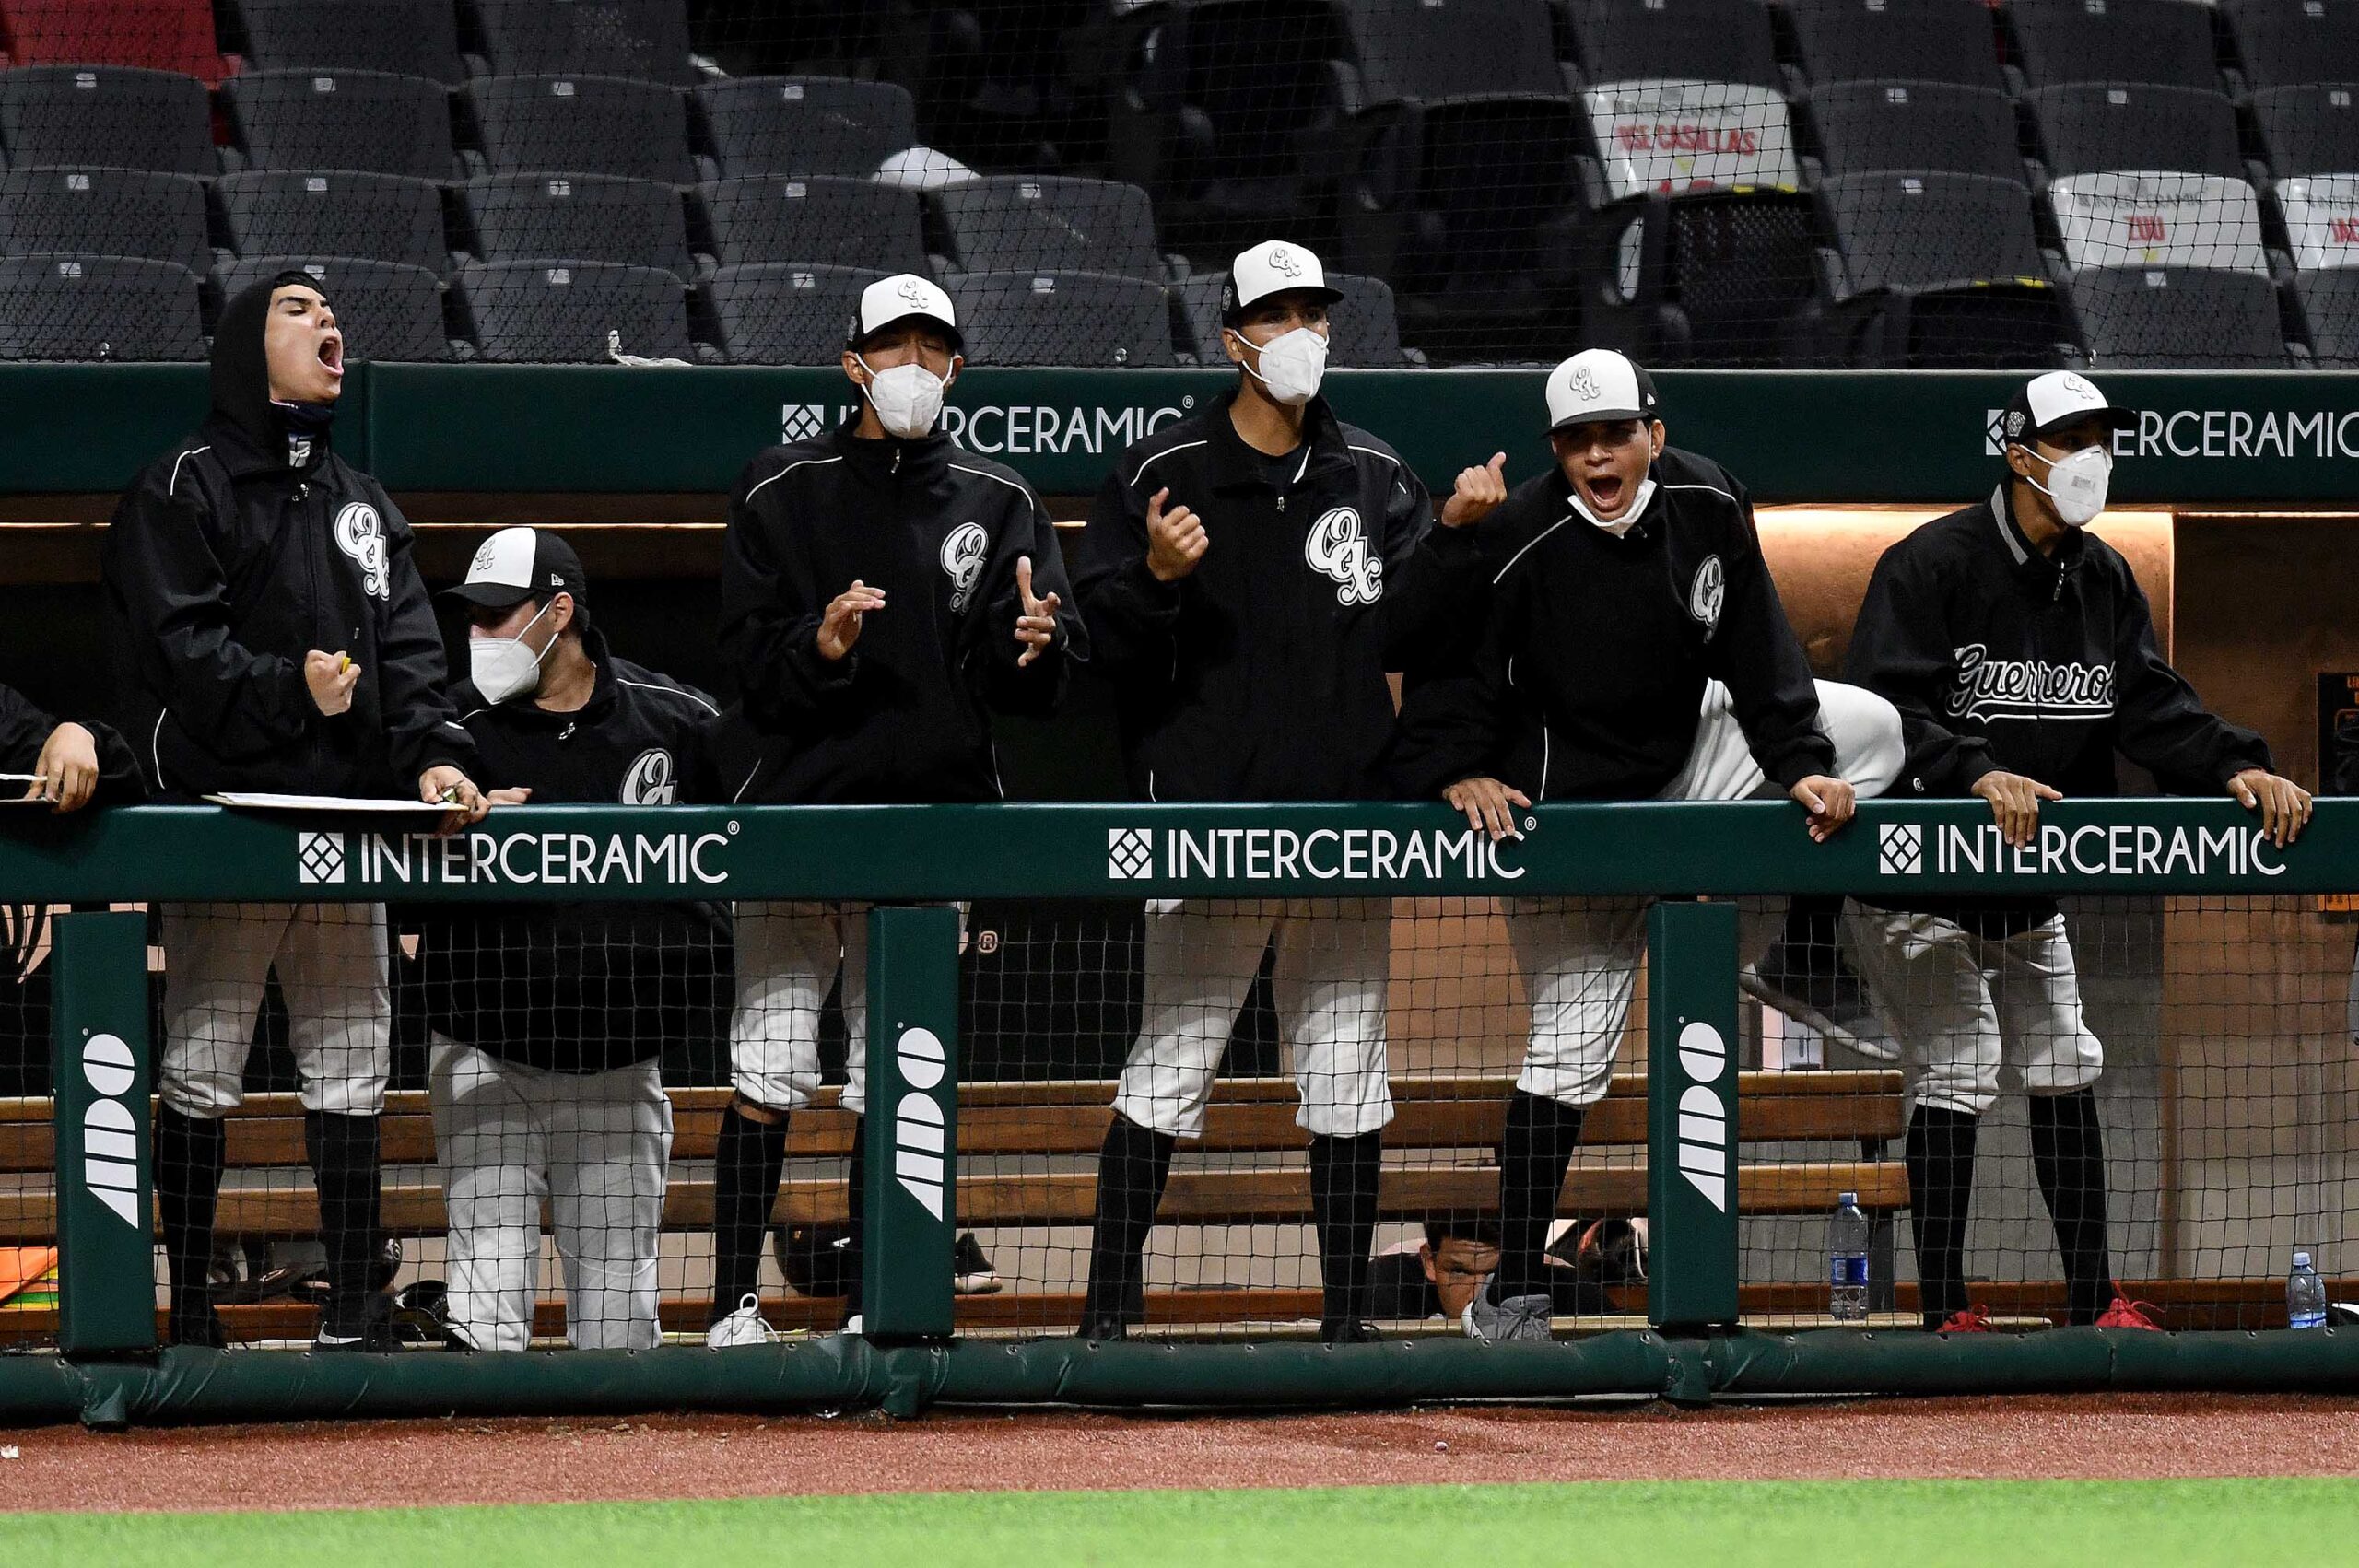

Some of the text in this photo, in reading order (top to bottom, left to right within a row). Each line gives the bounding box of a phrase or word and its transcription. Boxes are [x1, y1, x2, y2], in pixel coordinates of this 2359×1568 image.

[360, 832, 730, 884] INTERCERAMIC
[1168, 828, 1527, 880] INTERCERAMIC
[1937, 825, 2287, 876] INTERCERAMIC
